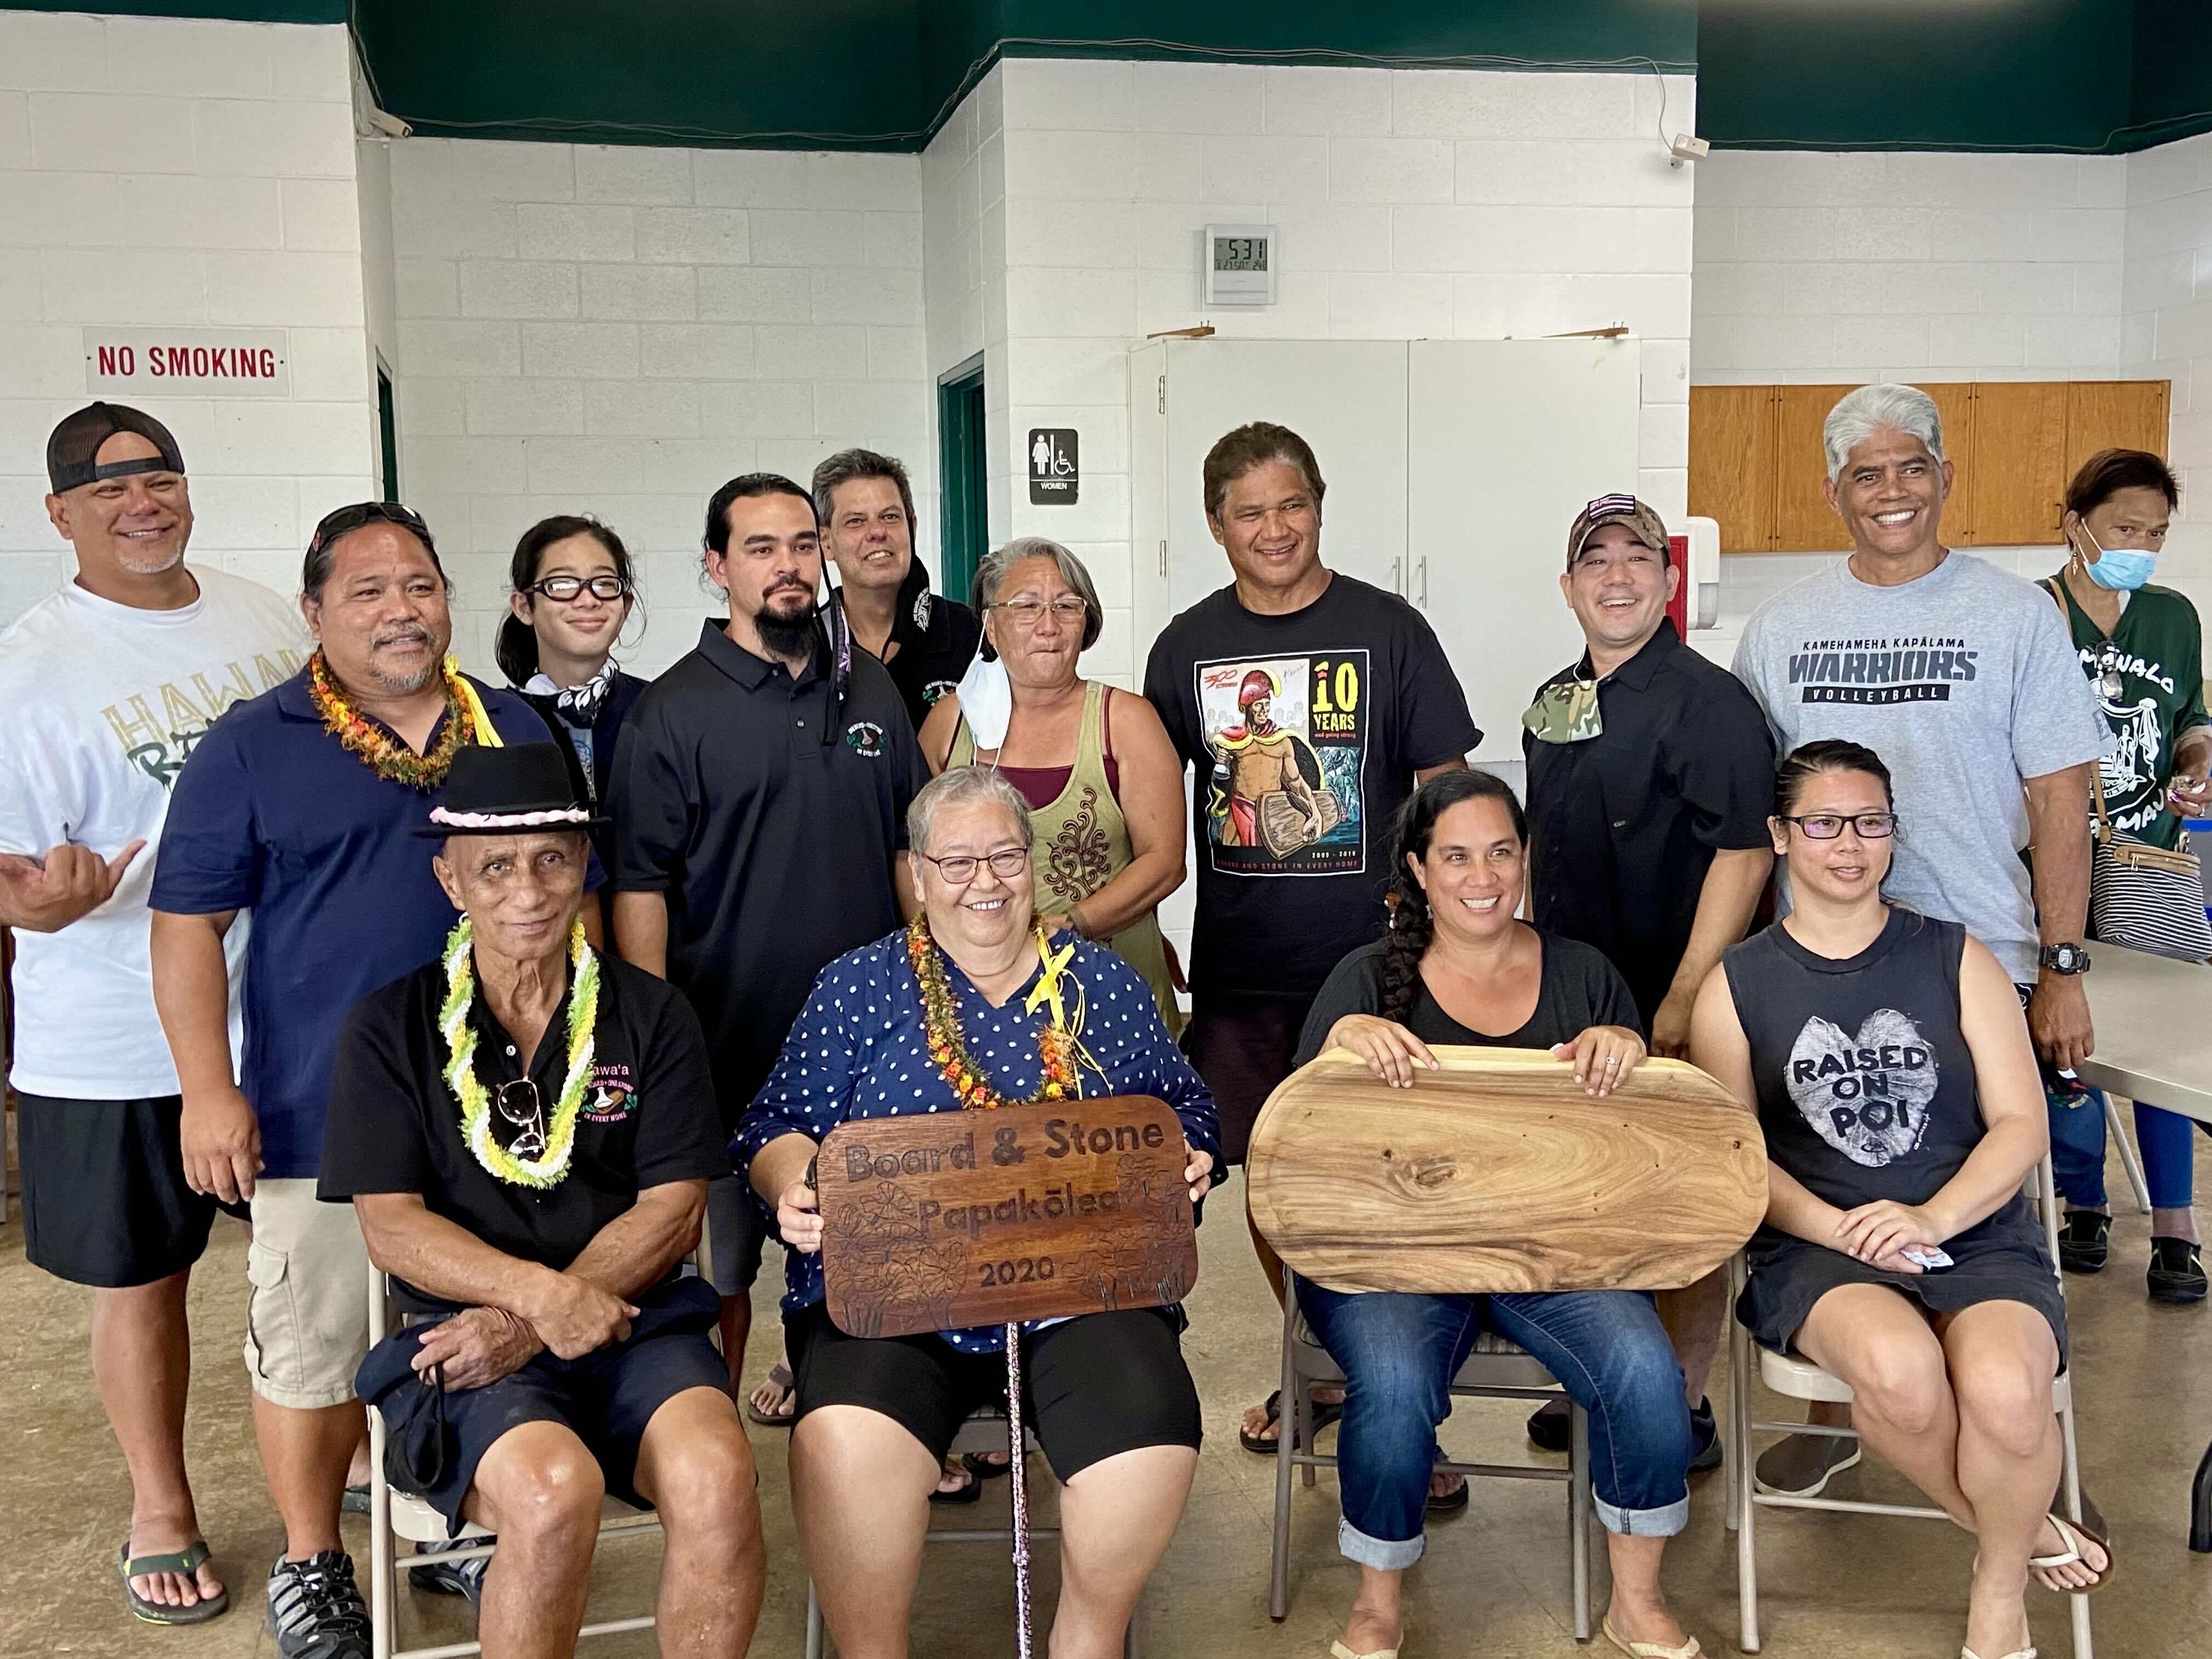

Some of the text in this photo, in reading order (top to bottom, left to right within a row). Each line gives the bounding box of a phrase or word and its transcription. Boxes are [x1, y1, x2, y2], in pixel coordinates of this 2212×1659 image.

[98, 346, 275, 377] NO SMOKING
[1803, 639, 1887, 651] KAMEHAMEHA
[1789, 651, 1978, 684] WARRIORS
[1312, 661, 1358, 713] 10
[1813, 687, 1938, 702] VOLLEYBALL
[1313, 713, 1356, 732] YEARS
[592, 1064, 629, 1075] awa'a
[1793, 1045, 1928, 1085] RAISED
[1832, 1074, 1888, 1100] ON
[591, 1114, 609, 1122] EVERY
[1830, 1099, 1909, 1138] POI
[844, 1118, 1165, 1183] Board & Stone
[917, 1182, 1121, 1240] Papakōlea
[978, 1256, 1056, 1288] 2020
